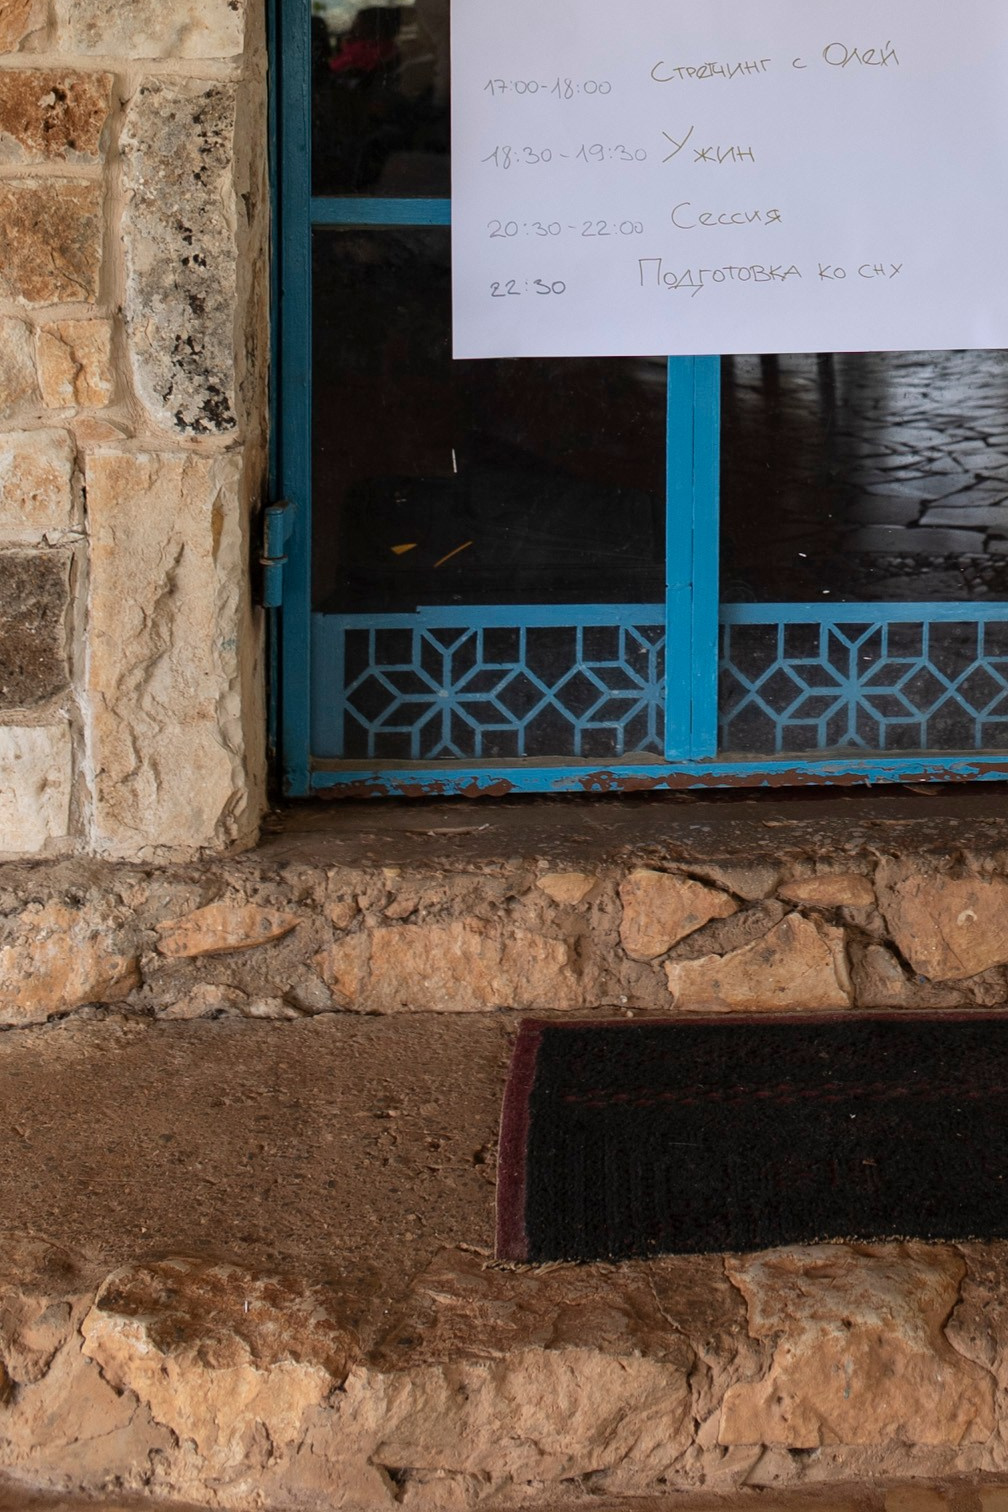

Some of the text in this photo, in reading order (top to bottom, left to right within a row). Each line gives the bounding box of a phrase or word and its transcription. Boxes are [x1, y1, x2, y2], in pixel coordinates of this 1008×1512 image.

[482, 77, 613, 100] 17:00-18:00
[486, 200, 784, 239] 20:30-22:00 Сессия
[488, 278, 567, 299] 22:30
